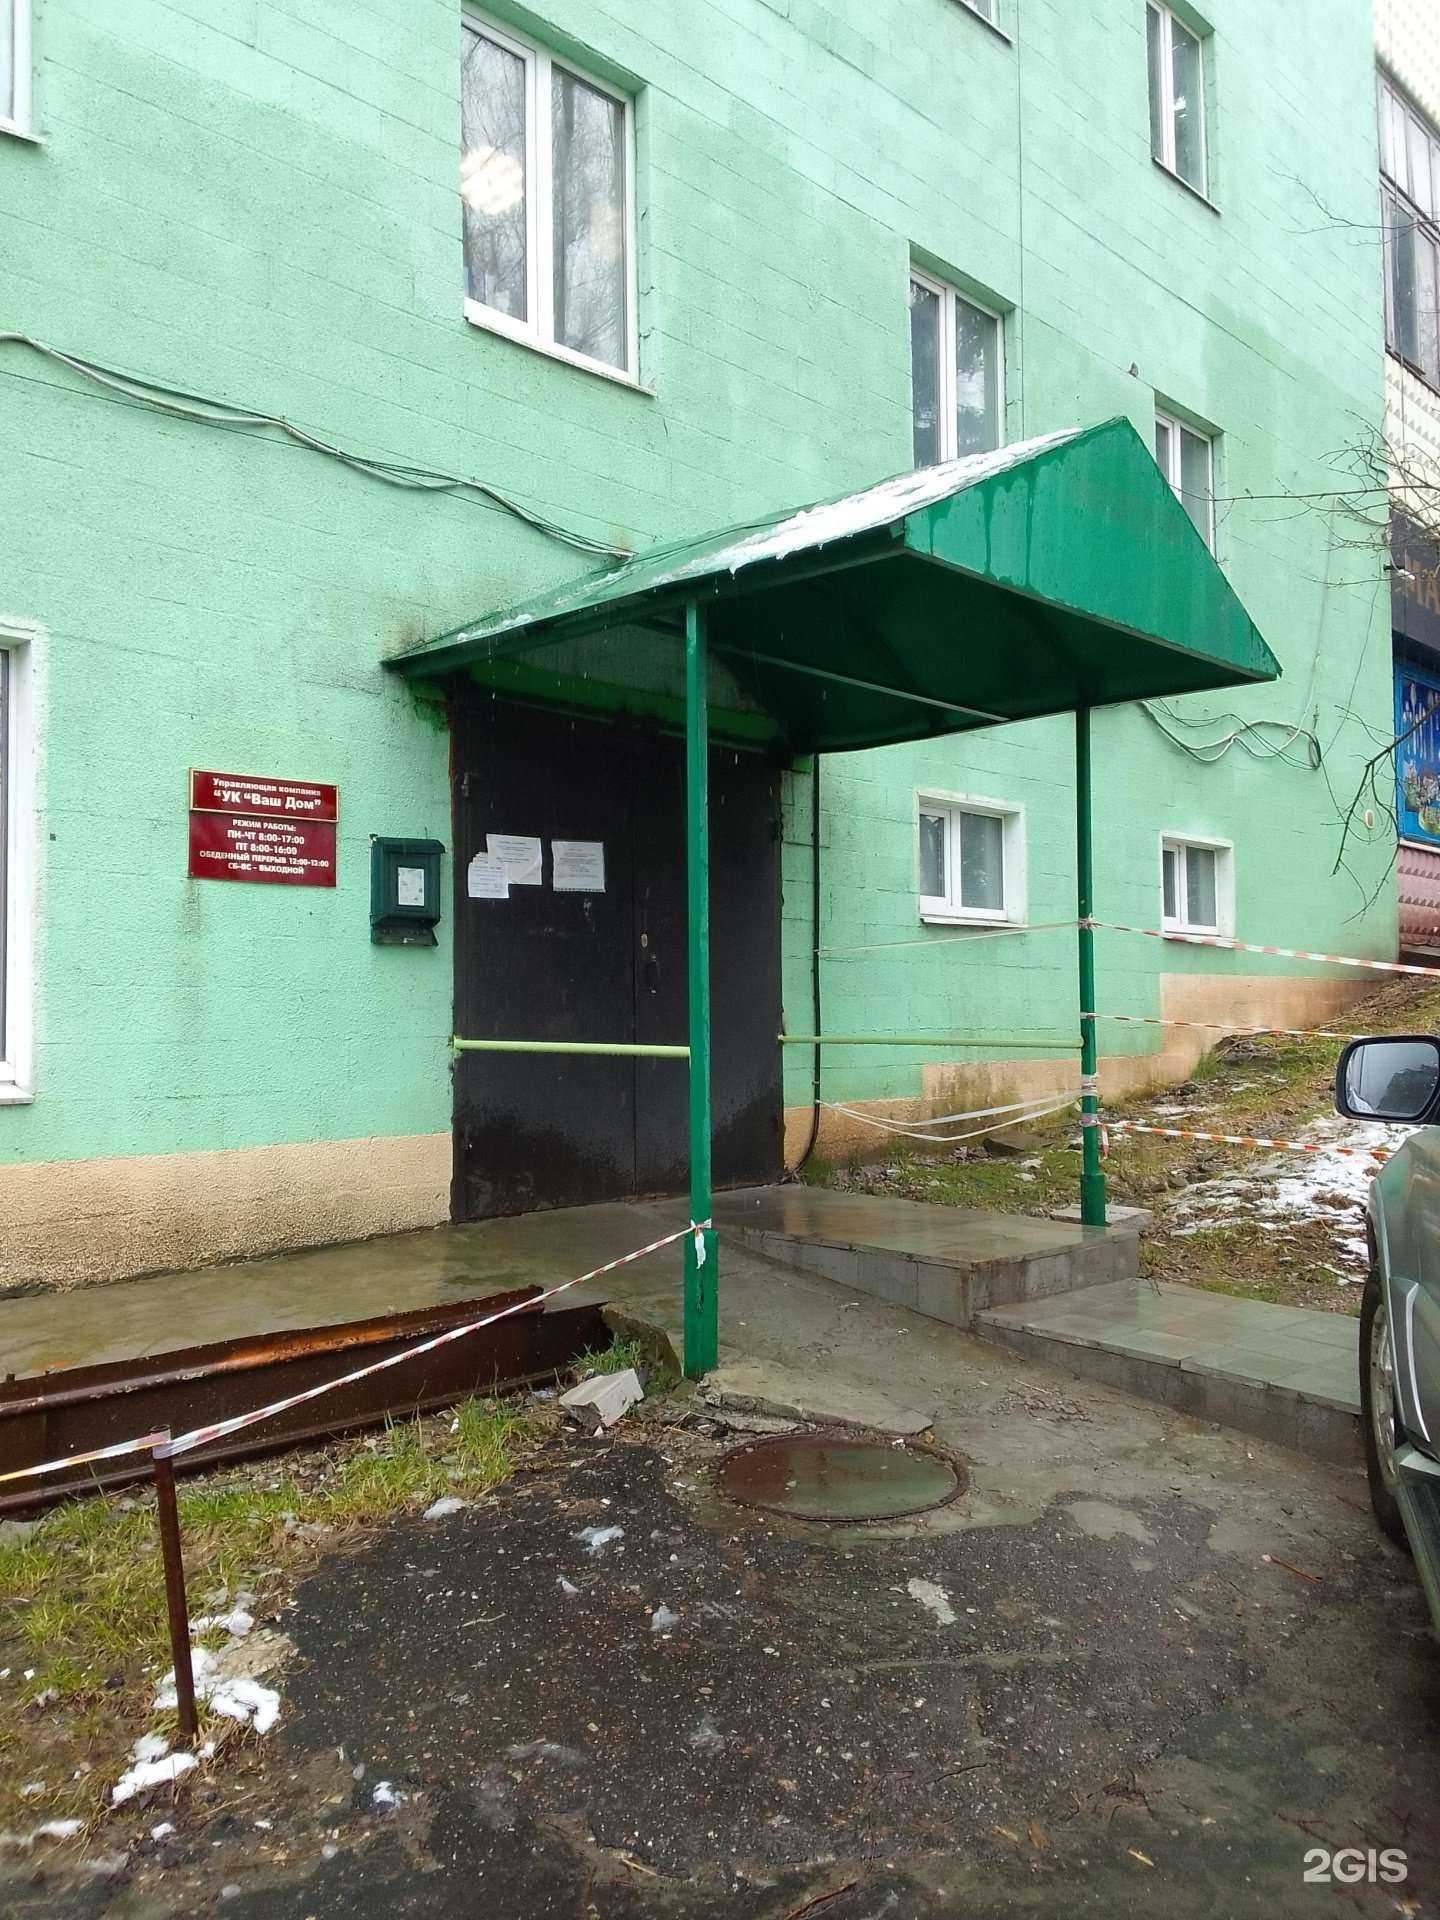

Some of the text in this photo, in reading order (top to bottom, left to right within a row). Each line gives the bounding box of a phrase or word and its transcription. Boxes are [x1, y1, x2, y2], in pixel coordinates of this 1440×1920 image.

[212, 778, 321, 796] Управляющая компания
[232, 819, 297, 832] РЕЖИМ РАБОТЫ:
[227, 830, 305, 844] ПН-ЧТ 8:00-17:00
[235, 842, 297, 855] ПТ 8:00-16:00
[199, 851, 250, 861] ОБЕДЕННЫЙ
[251, 854, 287, 864] ПЕРЕРЫВ
[228, 863, 252, 871] СБ-ВС
[258, 864, 305, 874] ВЫХОДНОЙ
